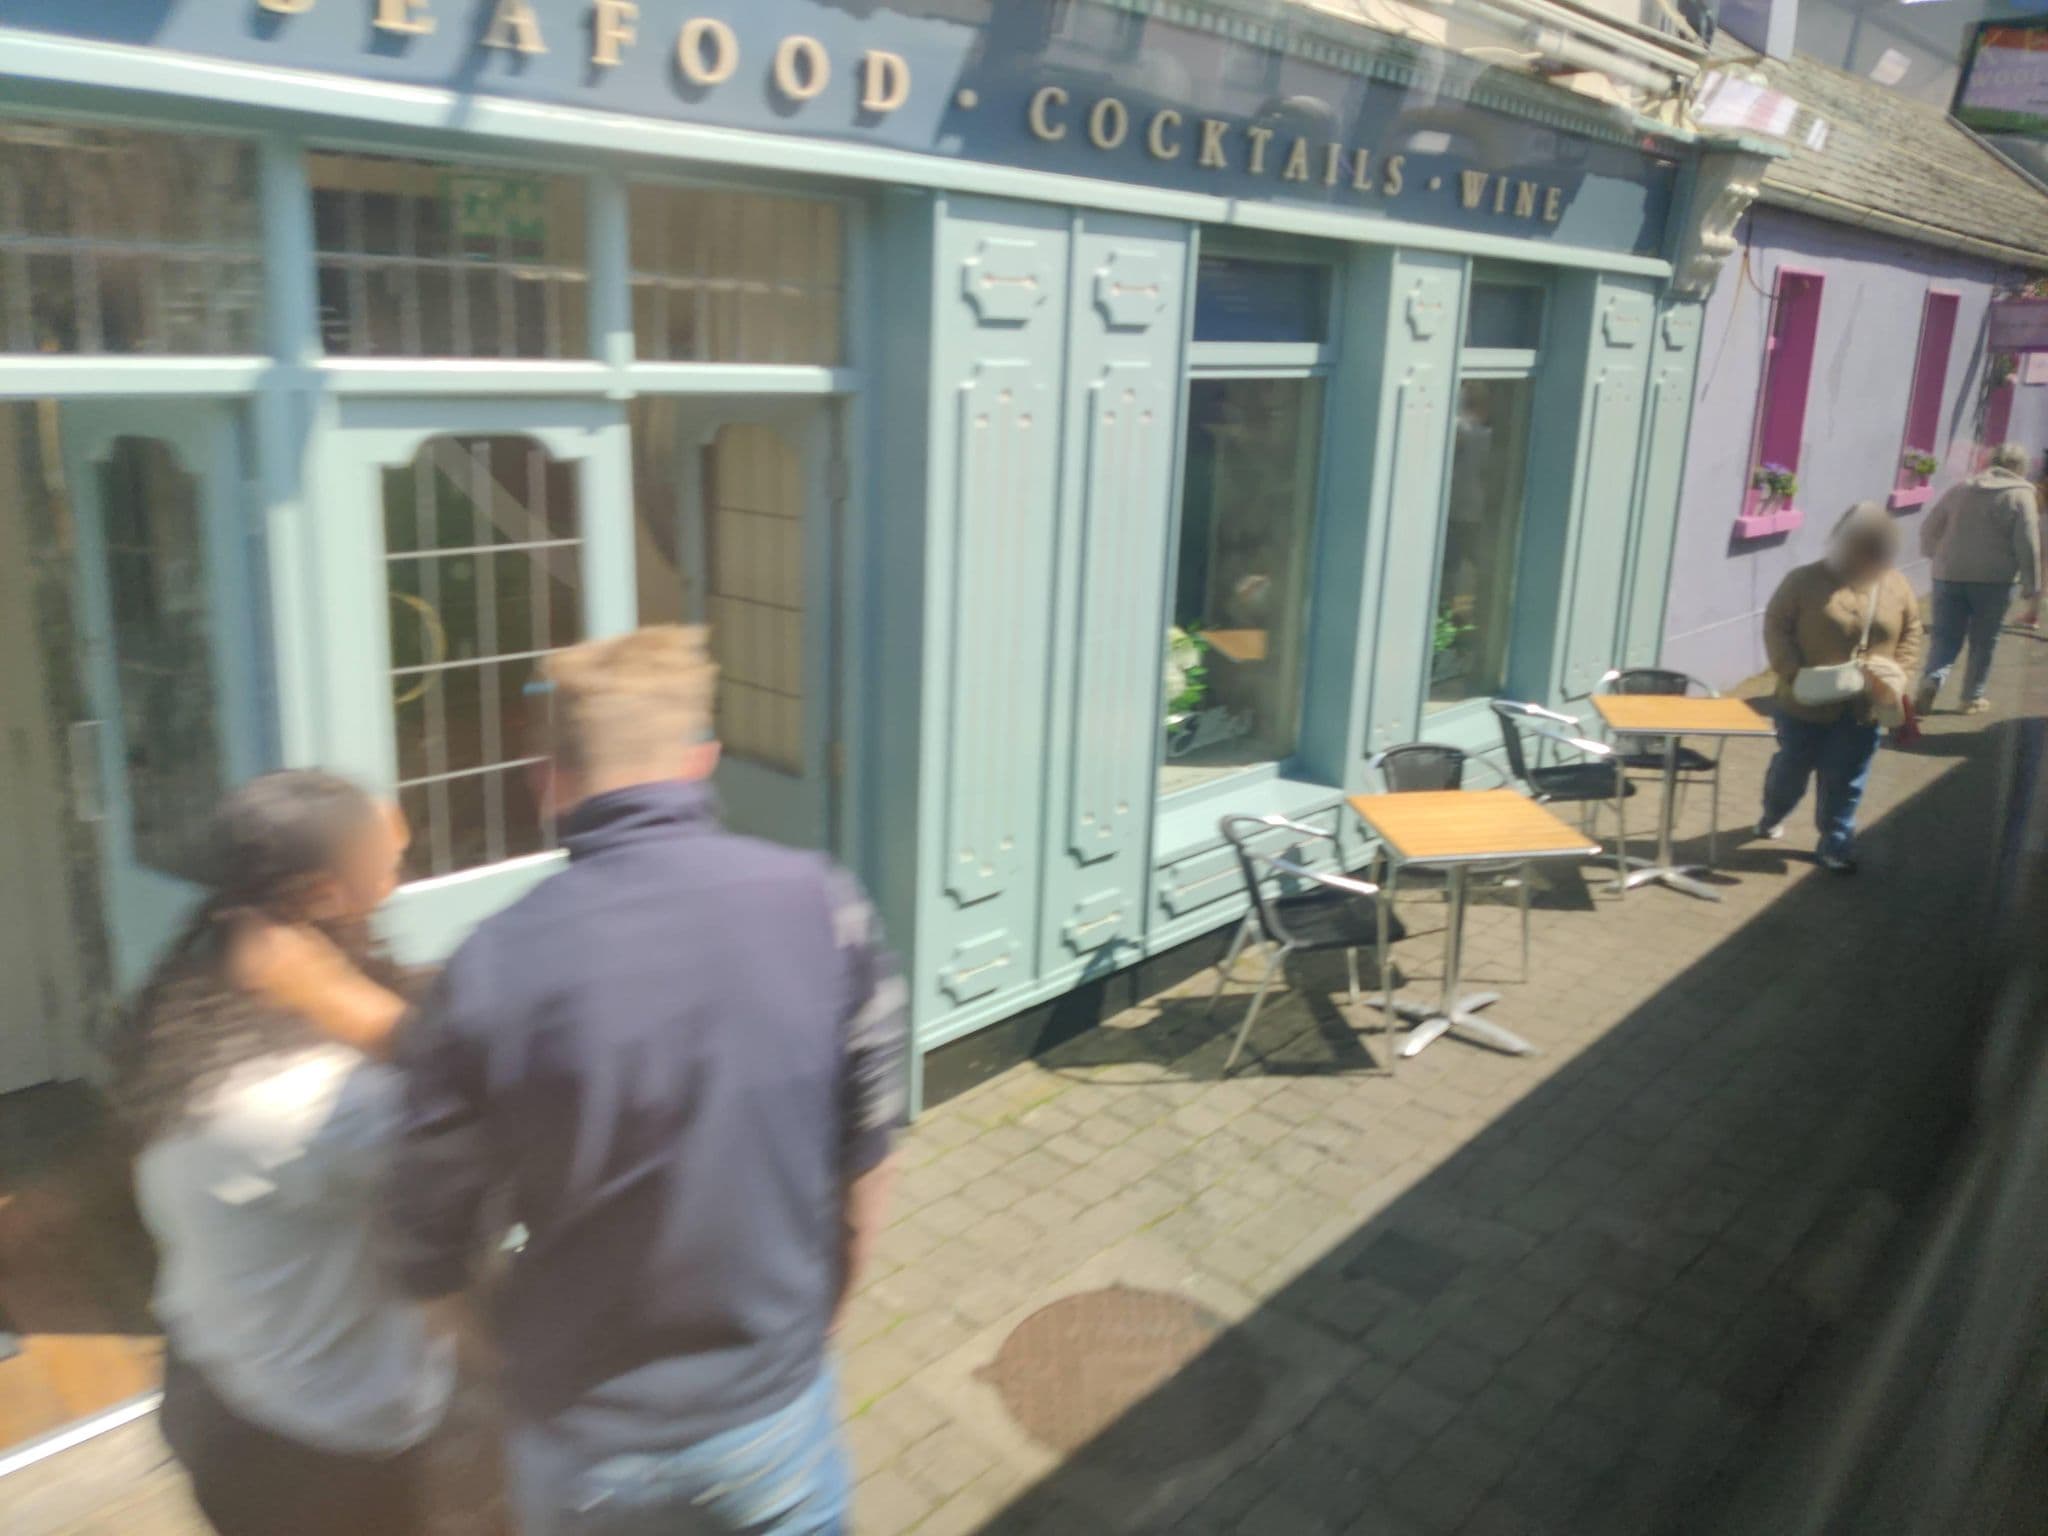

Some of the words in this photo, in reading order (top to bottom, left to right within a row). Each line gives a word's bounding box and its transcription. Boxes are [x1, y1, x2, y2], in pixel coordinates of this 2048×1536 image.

[256, 0, 910, 112] EAFOOD
[1029, 86, 1406, 196] COCKTAILS
[1460, 169, 1562, 223] WINE
